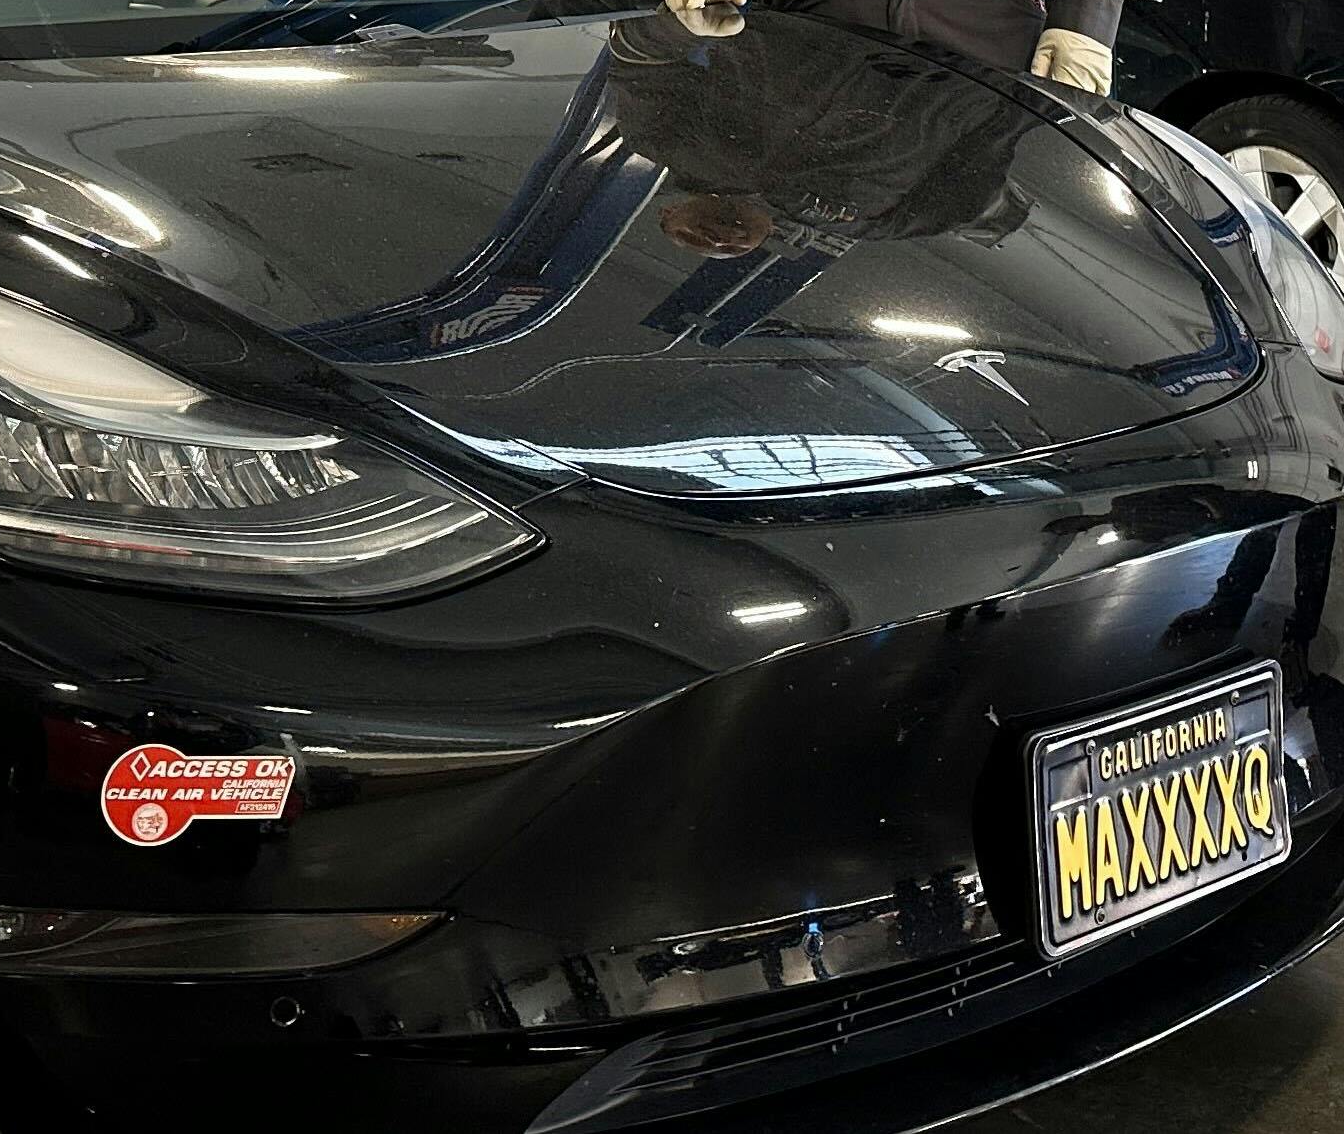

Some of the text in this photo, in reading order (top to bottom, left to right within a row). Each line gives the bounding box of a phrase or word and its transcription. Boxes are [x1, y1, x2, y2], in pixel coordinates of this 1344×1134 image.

[1099, 707, 1226, 780] CALIFORNIA
[149, 760, 289, 778] ACCESS OK
[222, 779, 286, 789] CALIFORNIA
[106, 788, 285, 801] CLEAN AIR VEHICLE
[1055, 742, 1274, 919] MAXXXXQ
